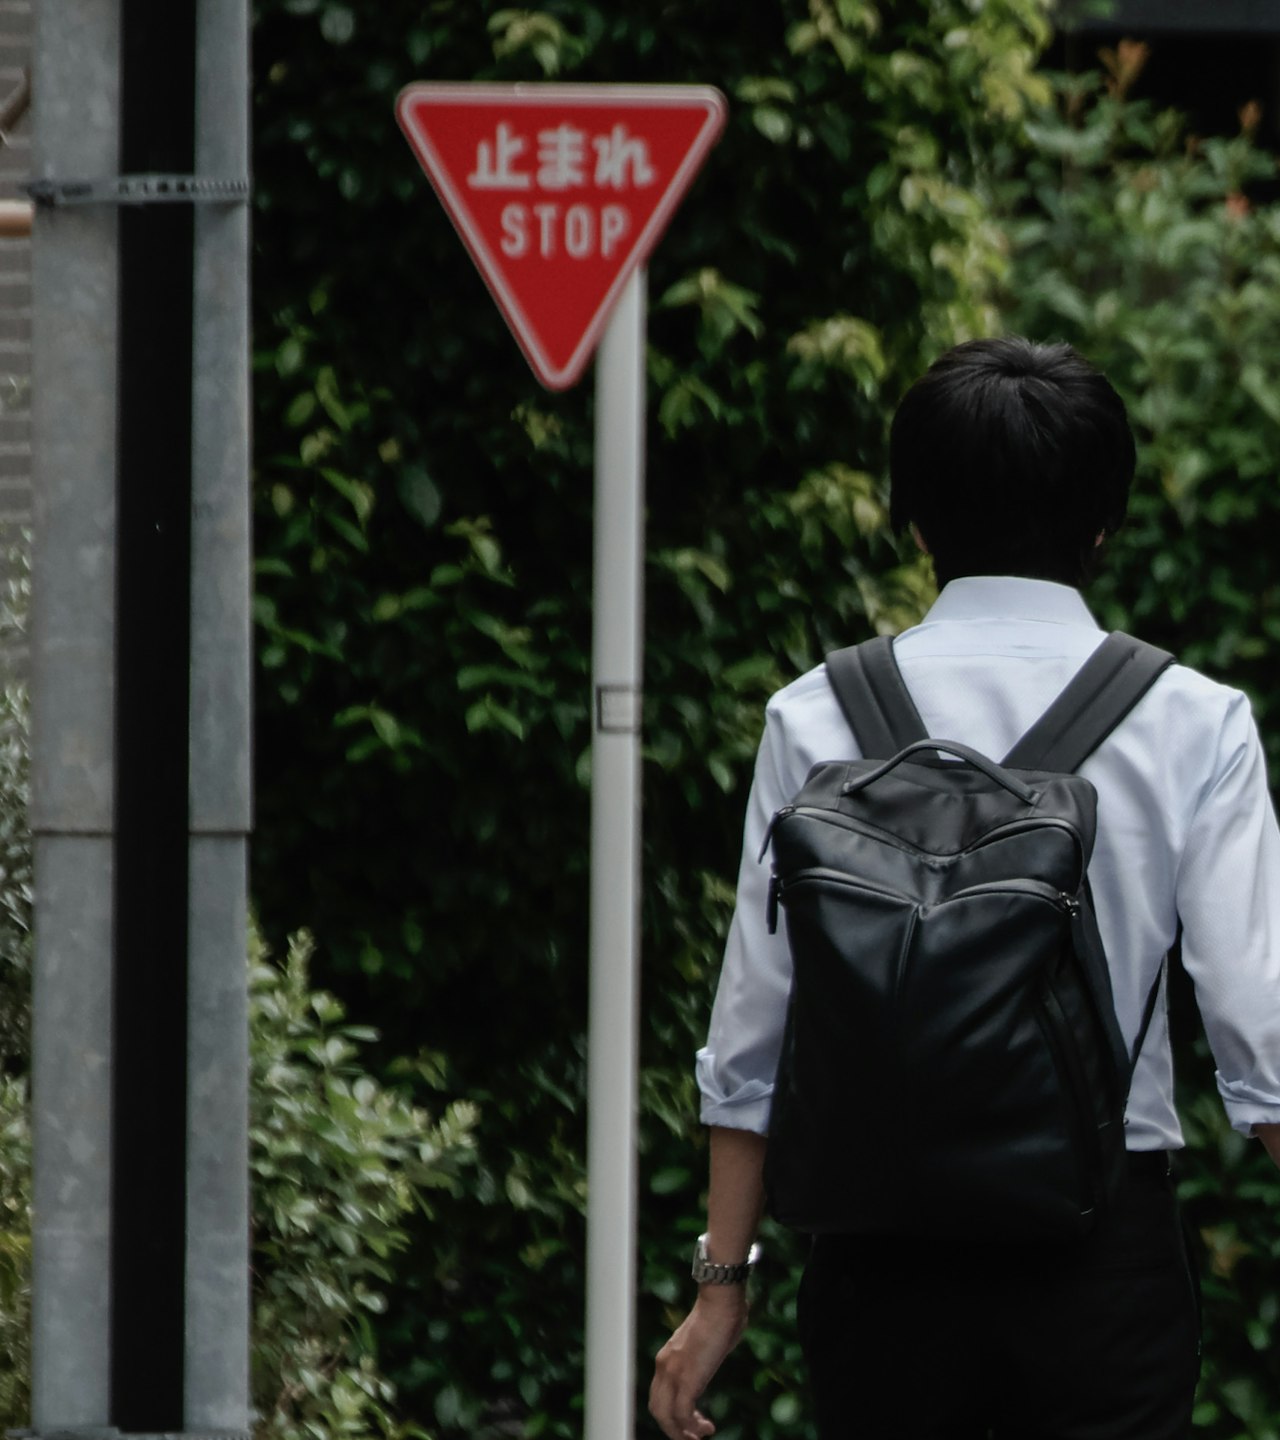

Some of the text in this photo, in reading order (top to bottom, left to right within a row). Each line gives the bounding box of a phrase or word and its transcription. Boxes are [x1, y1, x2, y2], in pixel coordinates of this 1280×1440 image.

[467, 122, 656, 190] 止まれ
[501, 203, 628, 259] STOP
